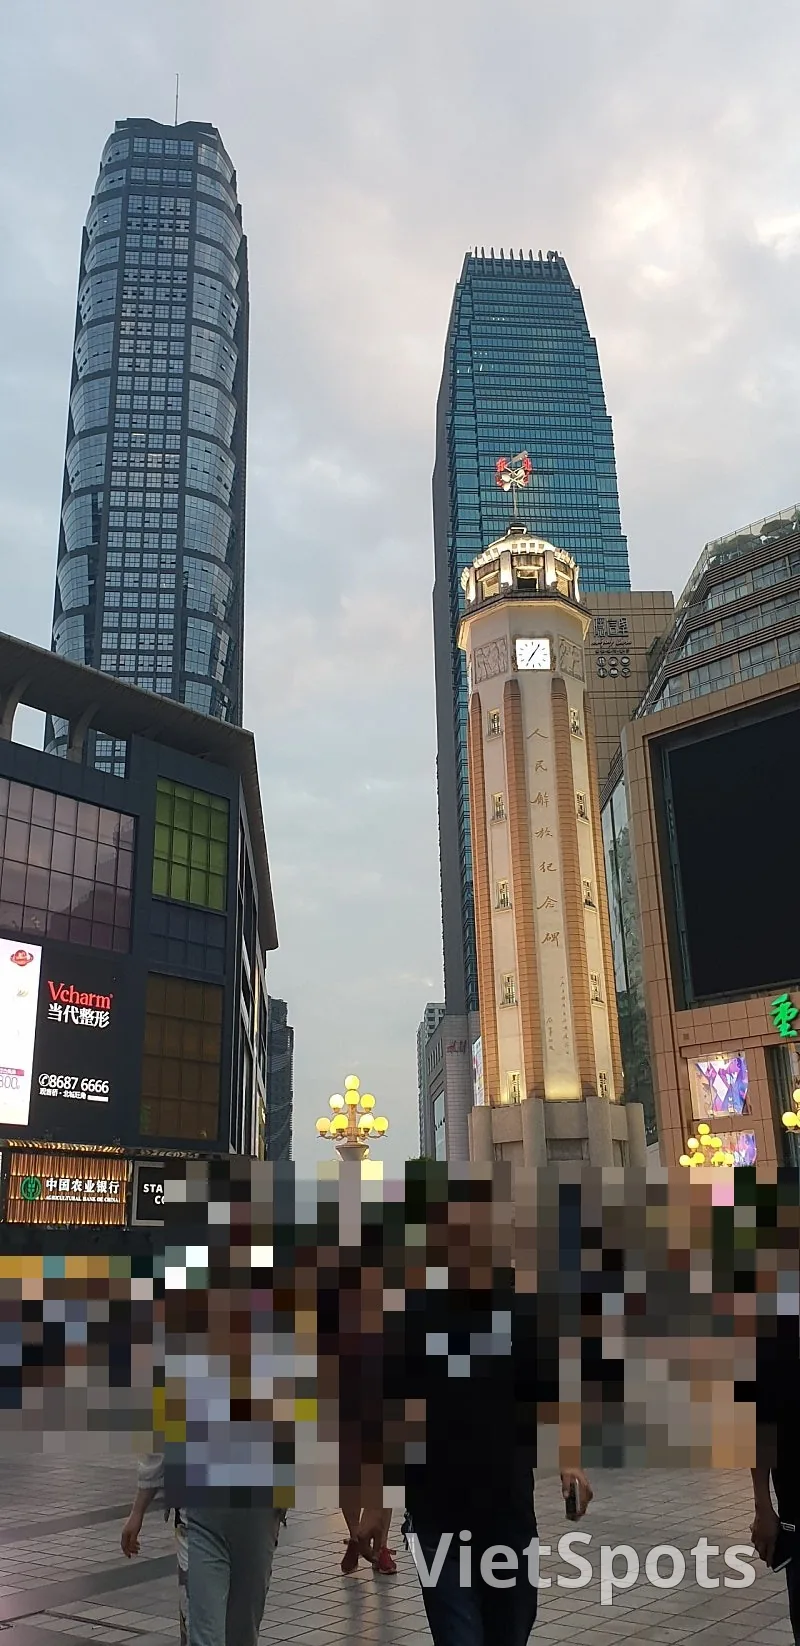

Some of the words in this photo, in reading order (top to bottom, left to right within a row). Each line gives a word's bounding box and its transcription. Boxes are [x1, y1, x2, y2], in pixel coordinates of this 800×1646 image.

[48, 981, 110, 1009] Vcharm
[47, 1003, 110, 1028] 当代整形
[49, 1074, 79, 1090] 8687
[81, 1078, 109, 1093] 6666
[46, 1178, 120, 1194] 中国农业银行
